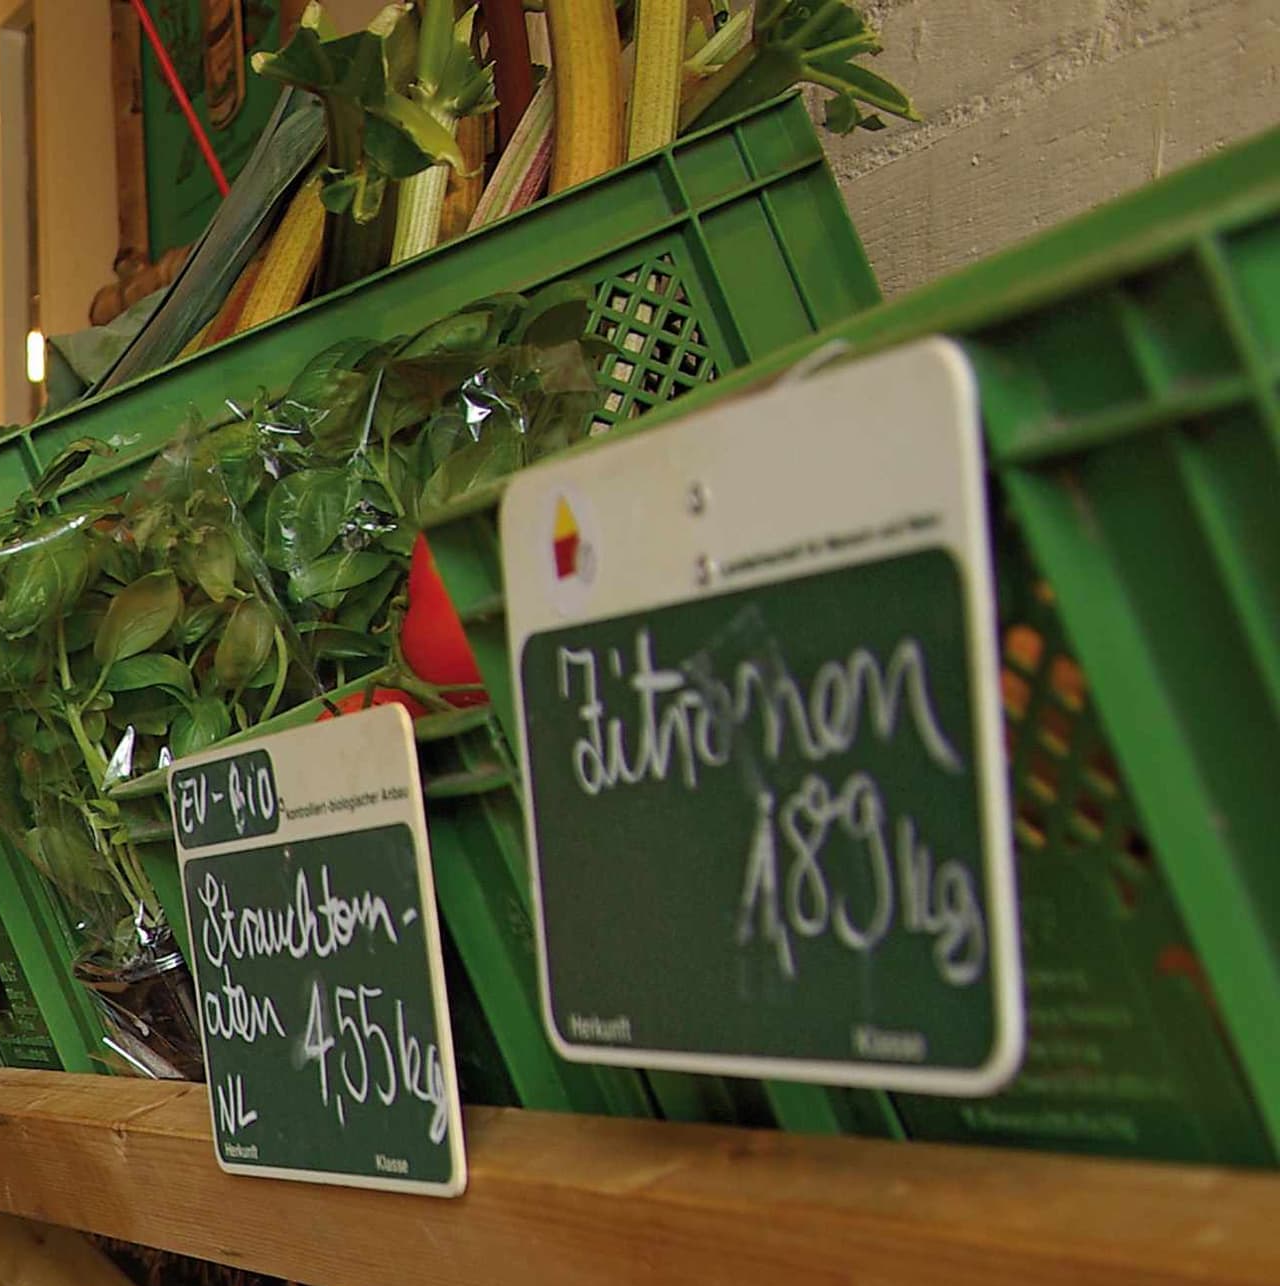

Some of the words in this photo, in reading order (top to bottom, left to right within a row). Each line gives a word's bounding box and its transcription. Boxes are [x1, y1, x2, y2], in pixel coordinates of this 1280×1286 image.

[557, 628, 965, 796] Zitronen
[569, 1012, 633, 1043] Herkunft
[217, 1072, 259, 1136] NL
[375, 1154, 410, 1174] Klasse
